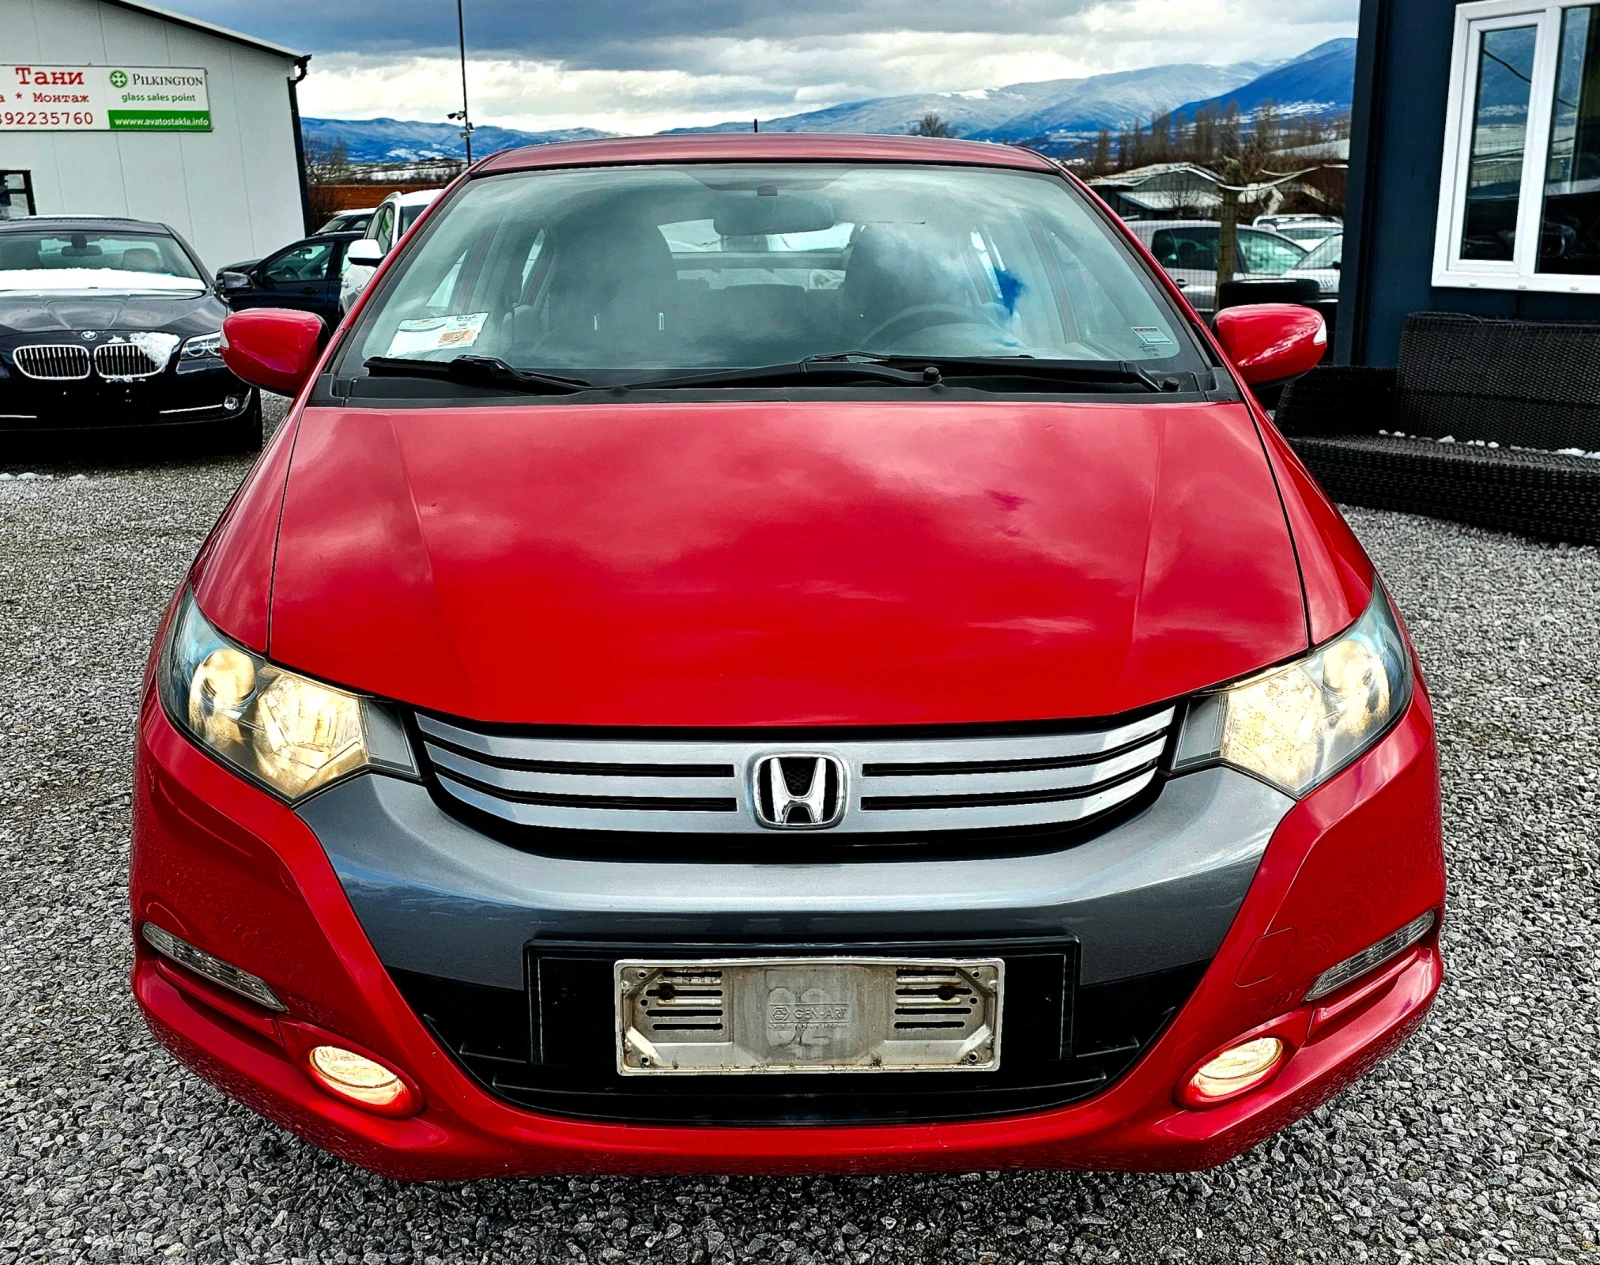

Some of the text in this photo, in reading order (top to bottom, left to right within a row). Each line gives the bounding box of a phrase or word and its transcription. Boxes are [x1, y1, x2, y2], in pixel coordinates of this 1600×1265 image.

[15, 67, 84, 85] Тани
[32, 92, 90, 103] Монтаж
[121, 92, 196, 103] glass sales point
[0, 111, 93, 125] 92235760
[793, 1007, 848, 1020] GEN-ART
